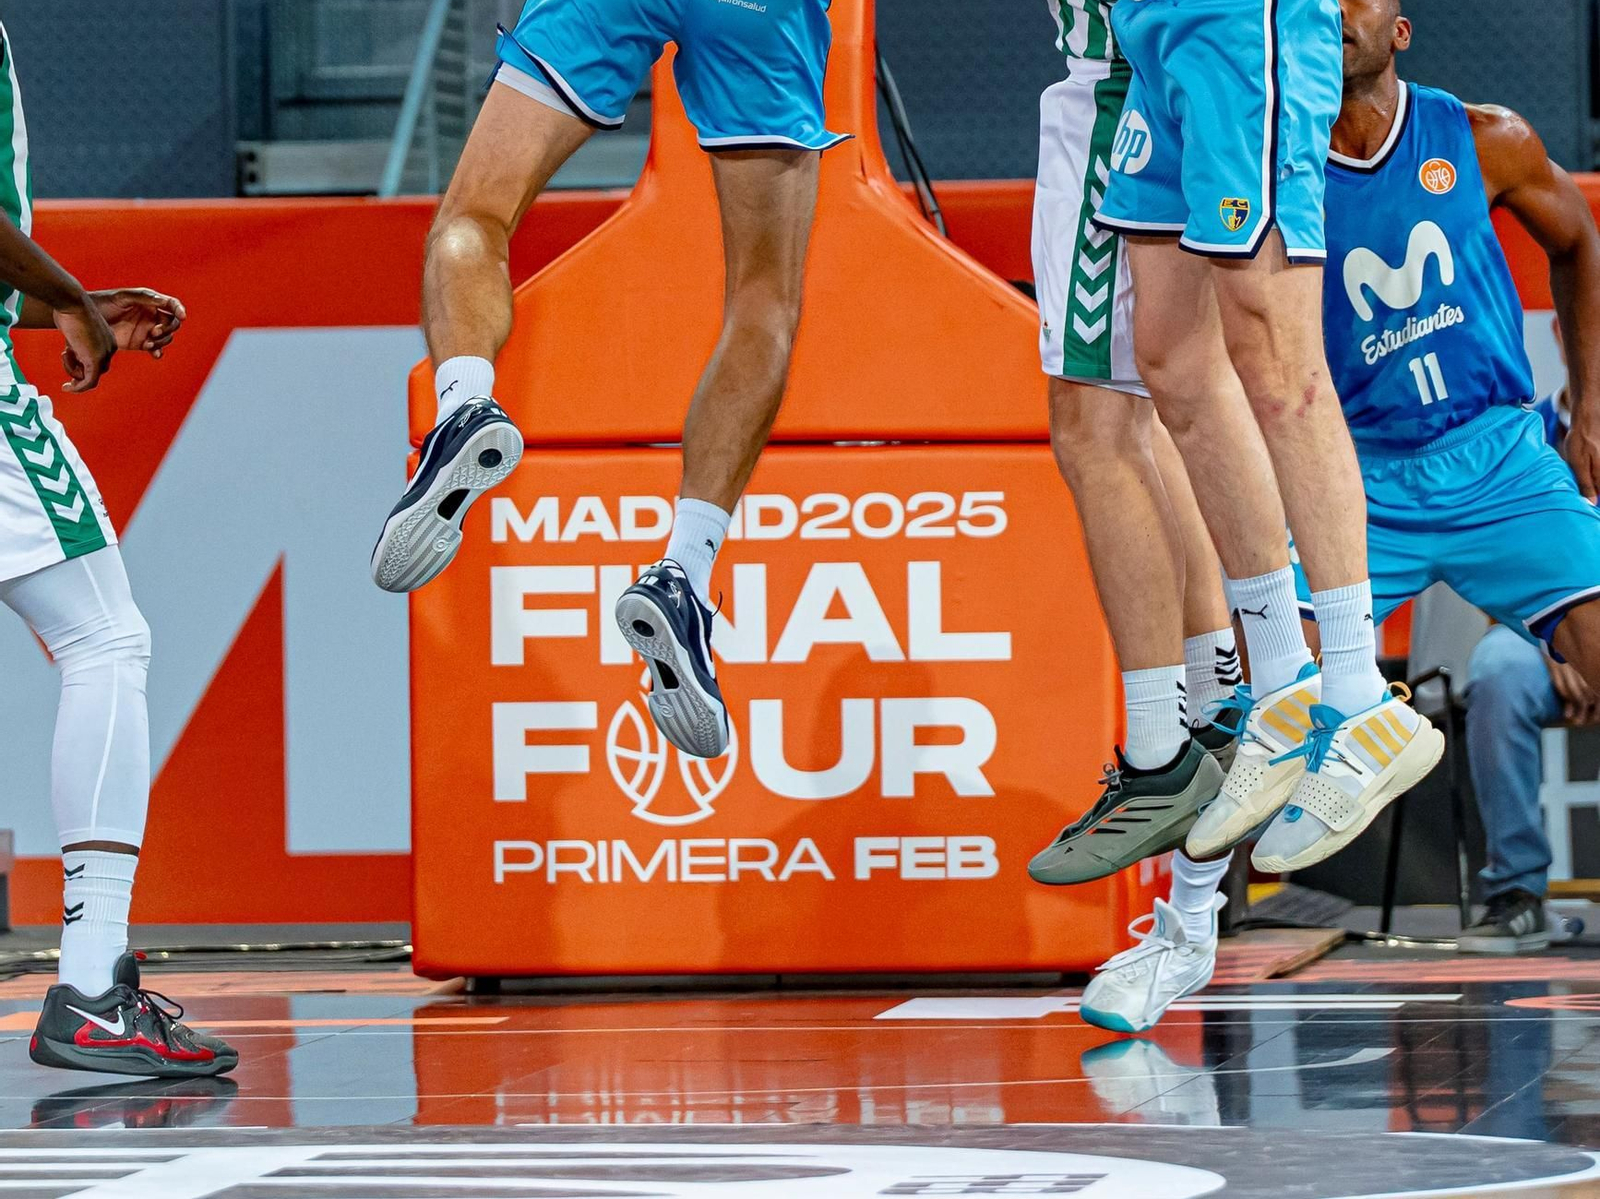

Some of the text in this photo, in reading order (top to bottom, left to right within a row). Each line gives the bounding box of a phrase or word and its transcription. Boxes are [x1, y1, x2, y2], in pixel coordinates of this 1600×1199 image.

[1112, 110, 1147, 173] hp
[1361, 303, 1465, 366] Estudiantes
[1408, 352, 1449, 406] 11
[493, 835, 1001, 884] PRIMERA FEB
